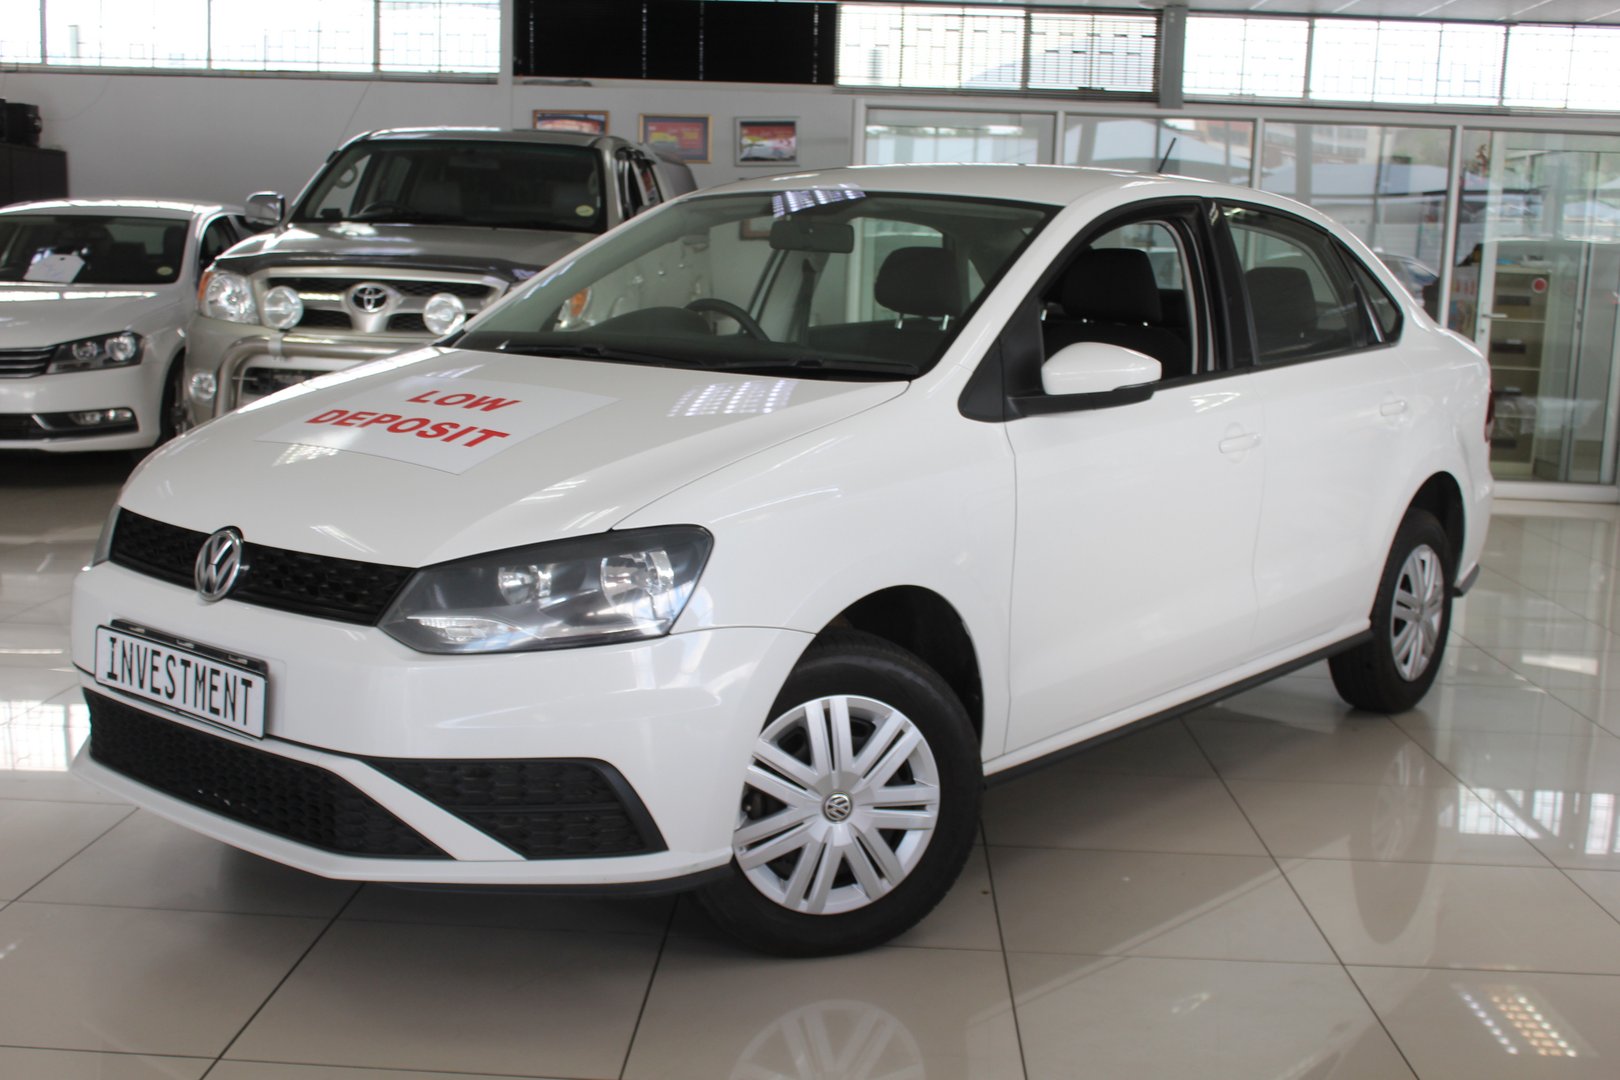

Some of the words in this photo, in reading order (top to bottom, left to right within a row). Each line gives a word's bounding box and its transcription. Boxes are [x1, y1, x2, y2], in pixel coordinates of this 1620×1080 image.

[406, 390, 521, 412] LOW
[304, 409, 511, 447] DEPOSIT
[107, 637, 252, 726] INVESTMENT
